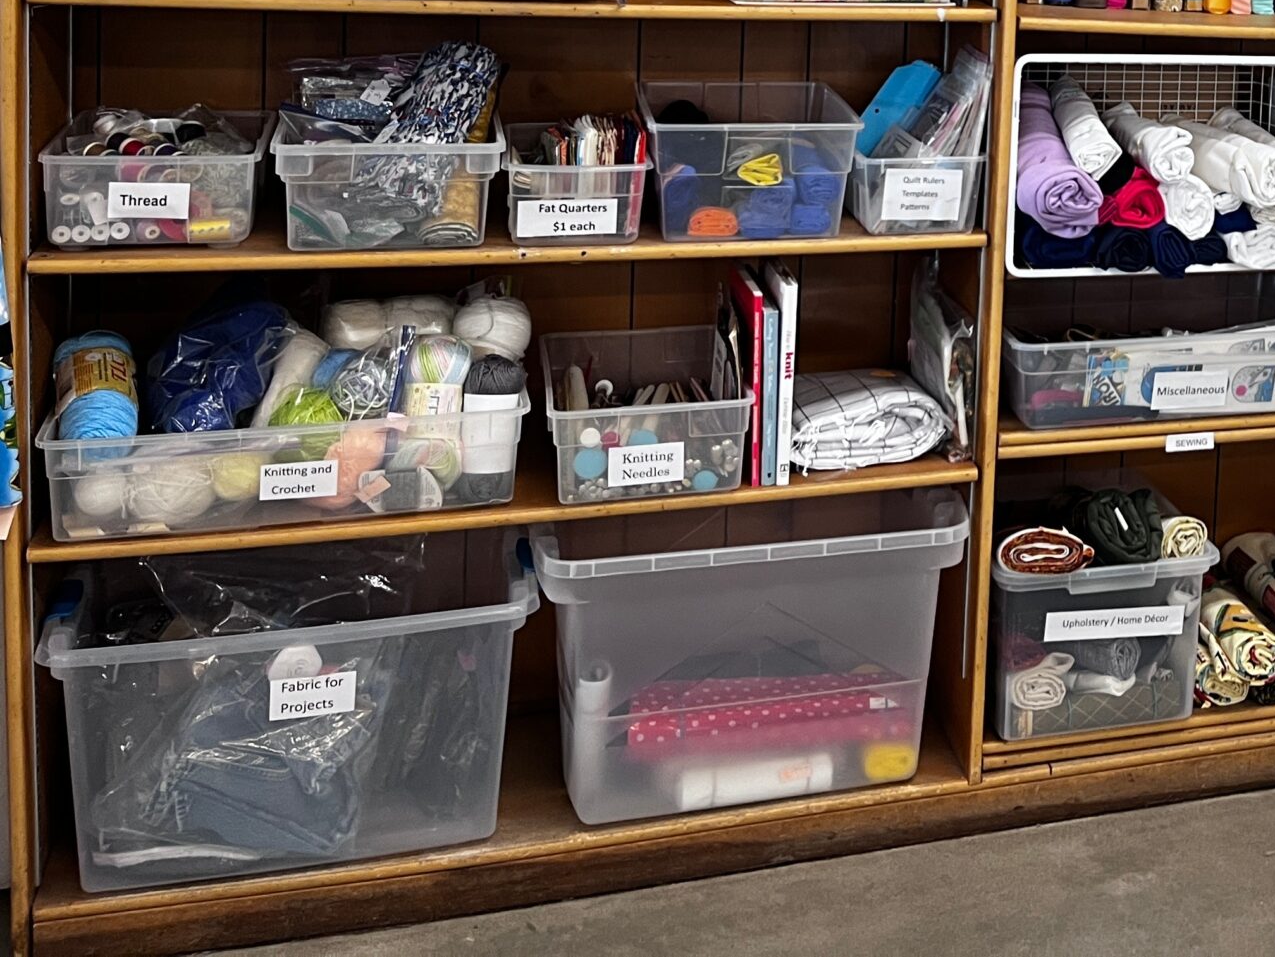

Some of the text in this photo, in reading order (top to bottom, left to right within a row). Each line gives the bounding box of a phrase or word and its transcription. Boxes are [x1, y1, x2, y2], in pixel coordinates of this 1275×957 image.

[903, 176, 945, 184] Quilt Rulers
[120, 194, 168, 206] Thread
[902, 190, 938, 198] Templates
[539, 204, 608, 214] Fat Quarters
[553, 222, 596, 232] $1 each
[784, 352, 794, 380] knit
[1156, 384, 1224, 396] Miscellaneous
[1176, 438, 1208, 447] SEWING
[622, 452, 674, 464] Knitting
[264, 464, 332, 476] Knitting and
[622, 467, 670, 480] Needles
[272, 484, 316, 494] Crochet
[1062, 614, 1169, 629] Upholstery / Home Décor
[282, 676, 344, 693] Fabric for
[280, 700, 334, 714] Projects
